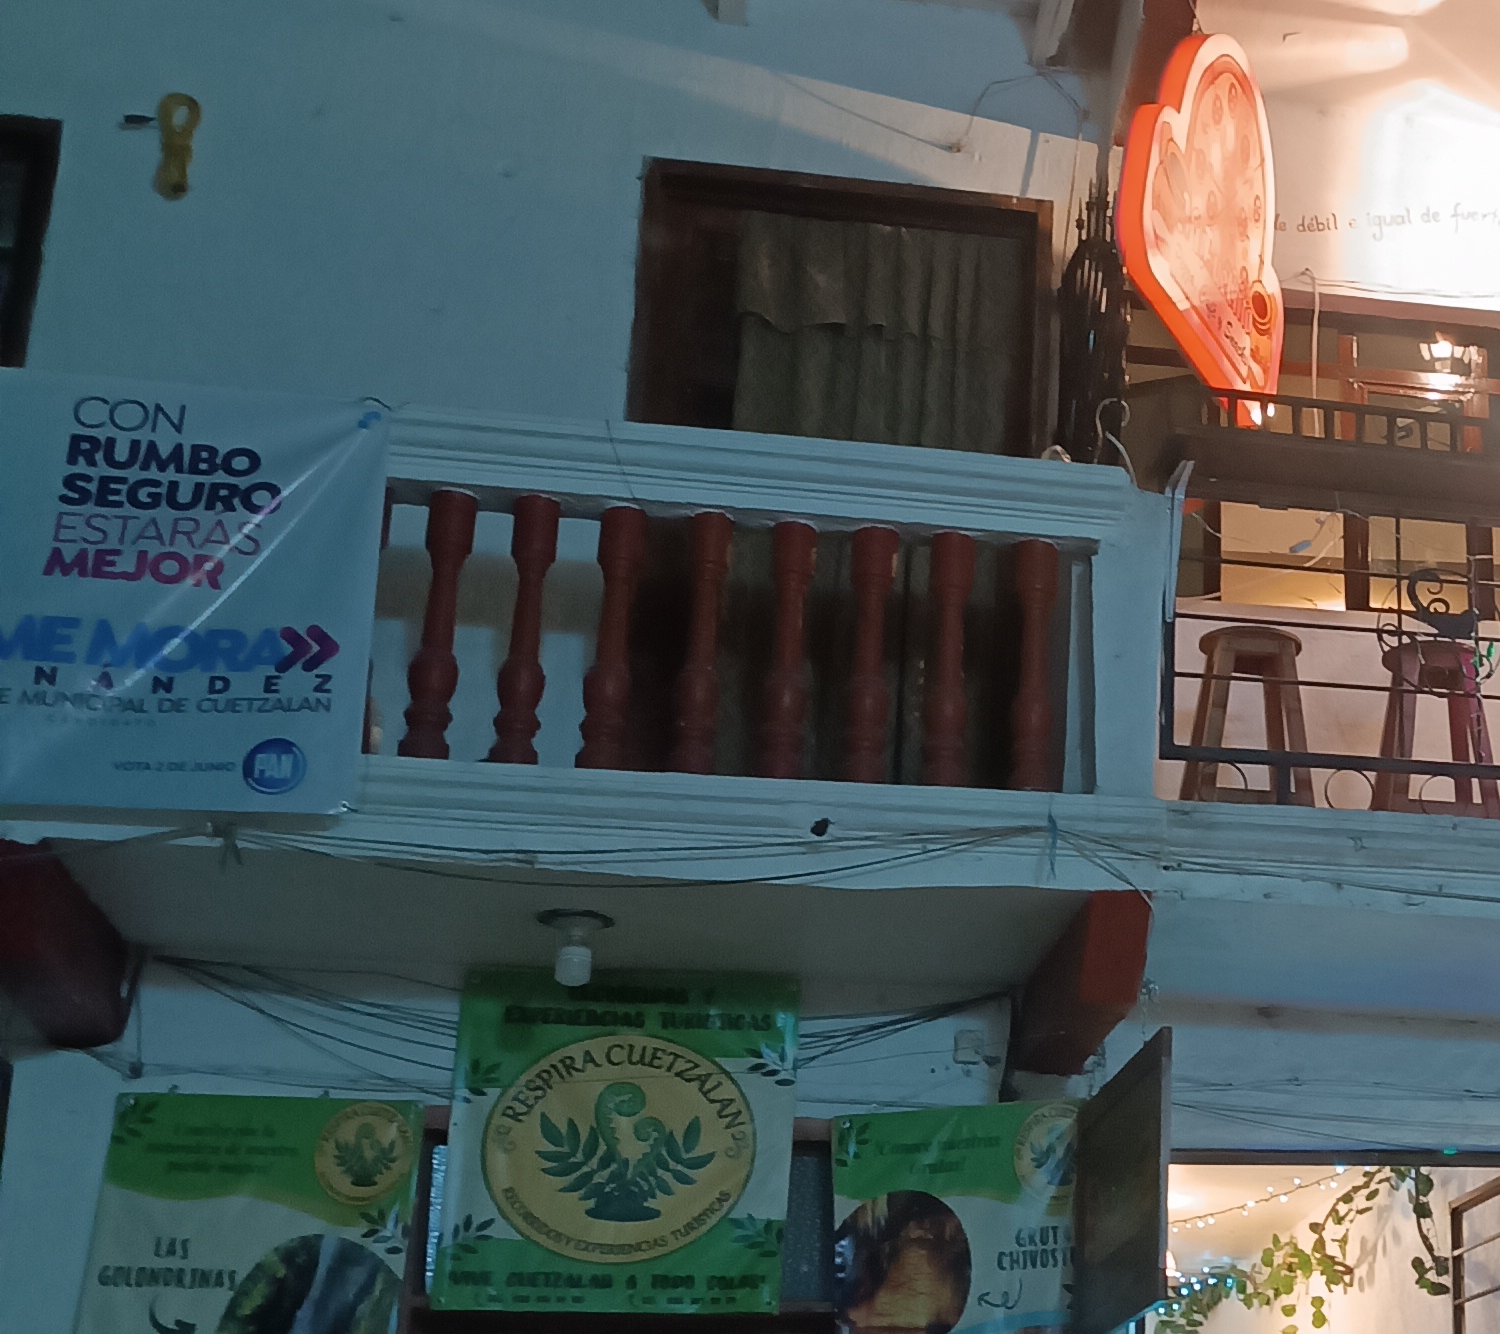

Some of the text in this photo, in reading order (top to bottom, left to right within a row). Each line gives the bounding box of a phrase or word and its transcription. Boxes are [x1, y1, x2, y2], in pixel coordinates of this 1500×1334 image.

[1297, 213, 1338, 233] débil
[1367, 209, 1412, 242] igual
[1420, 207, 1440, 223] de
[73, 396, 186, 435] CON
[65, 433, 261, 477] RUMBO
[58, 473, 282, 515] SEGURO
[43, 547, 224, 590] MEJOR
[85, 619, 283, 673] MORA
[33, 663, 333, 695] NÁNDEZ
[158, 698, 188, 714] DE
[196, 697, 331, 714] CUETZALAN
[252, 752, 294, 781] PAN
[502, 1043, 745, 1130] RESPIRA CUETZALAN
[153, 1236, 189, 1260] LAS
